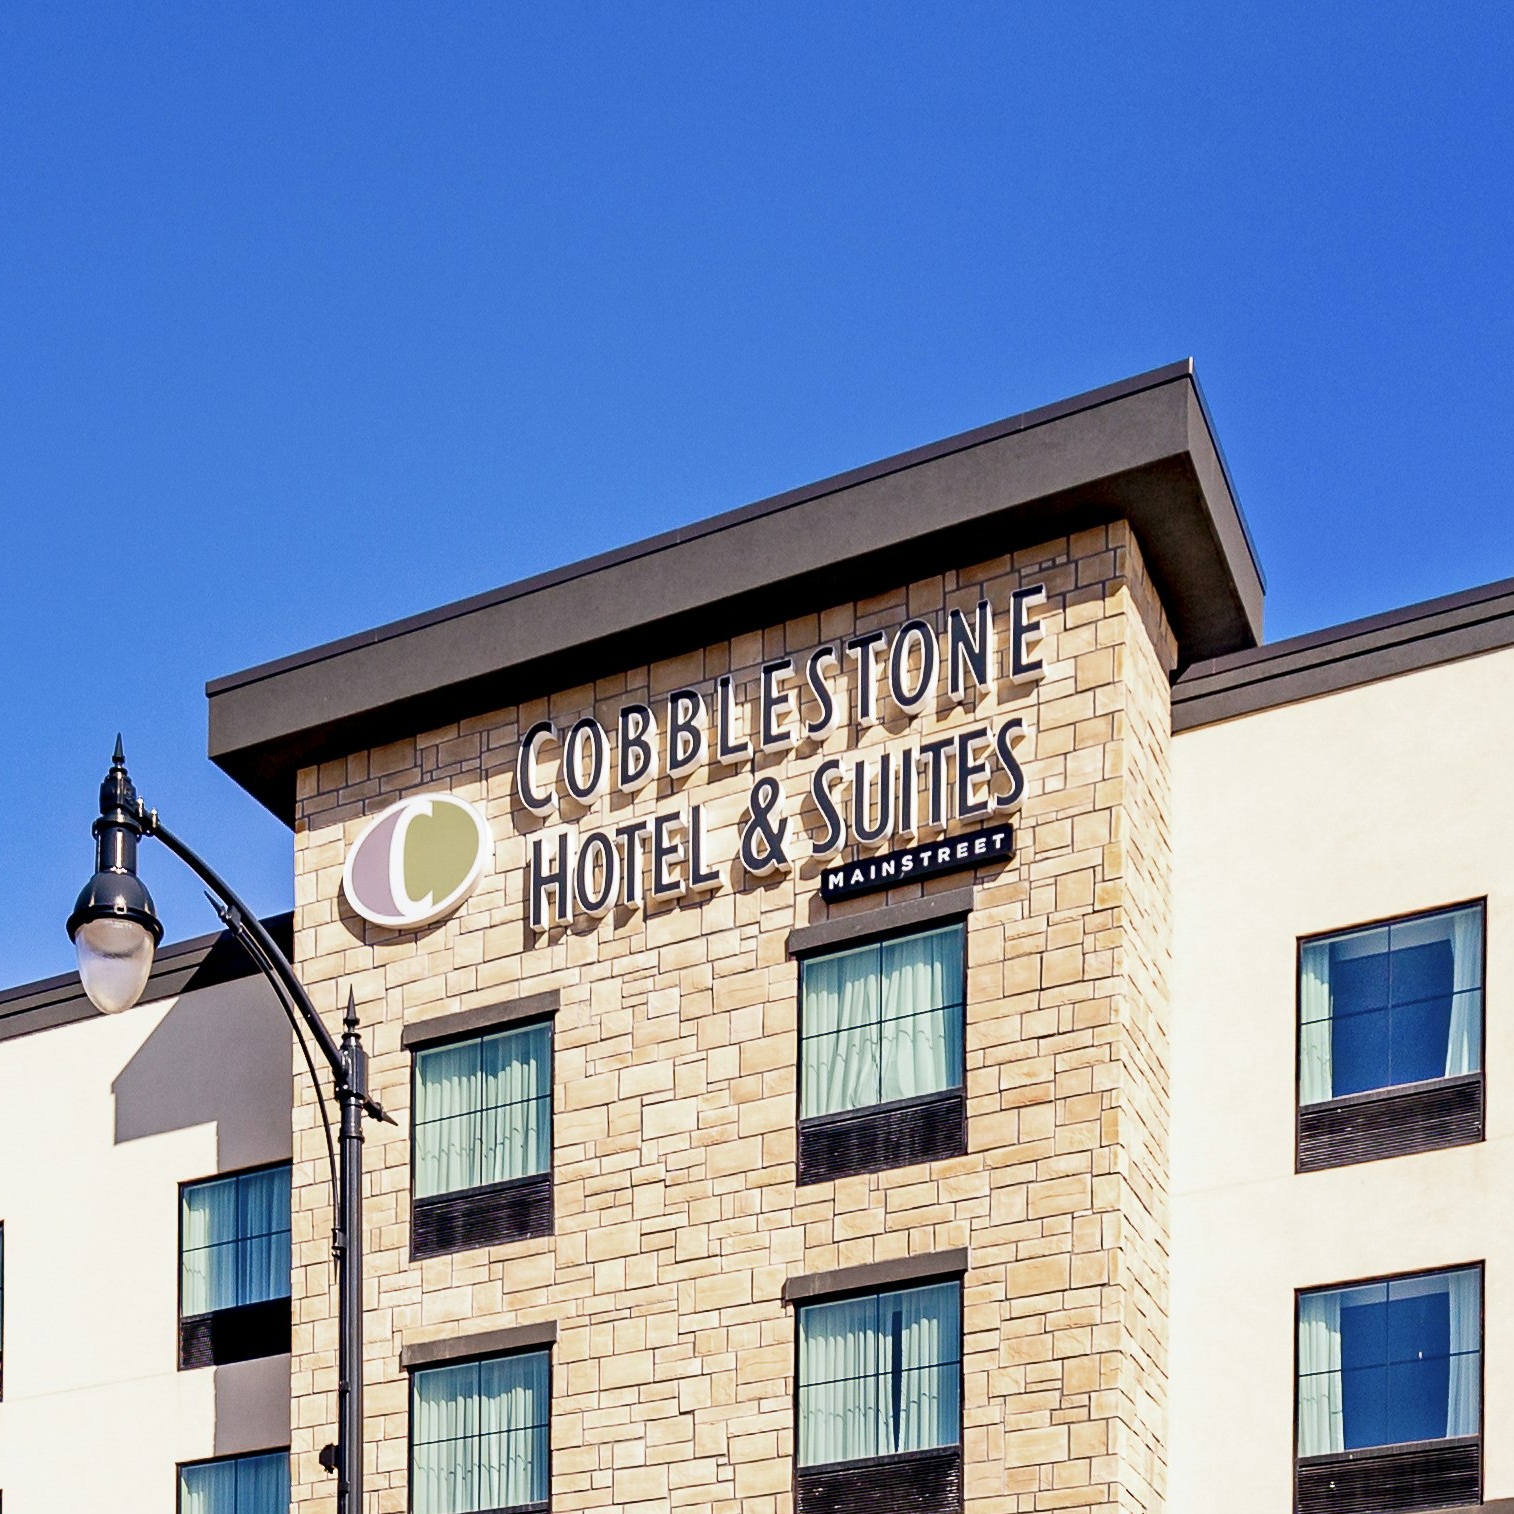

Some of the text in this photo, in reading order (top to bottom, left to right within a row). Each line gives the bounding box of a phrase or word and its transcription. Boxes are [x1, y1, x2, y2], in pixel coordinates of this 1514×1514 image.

[517, 583, 1047, 817] COBBLESTONE
[529, 717, 1029, 932] HOTEL & SUITES
[828, 832, 1007, 890] MAINSTREET
